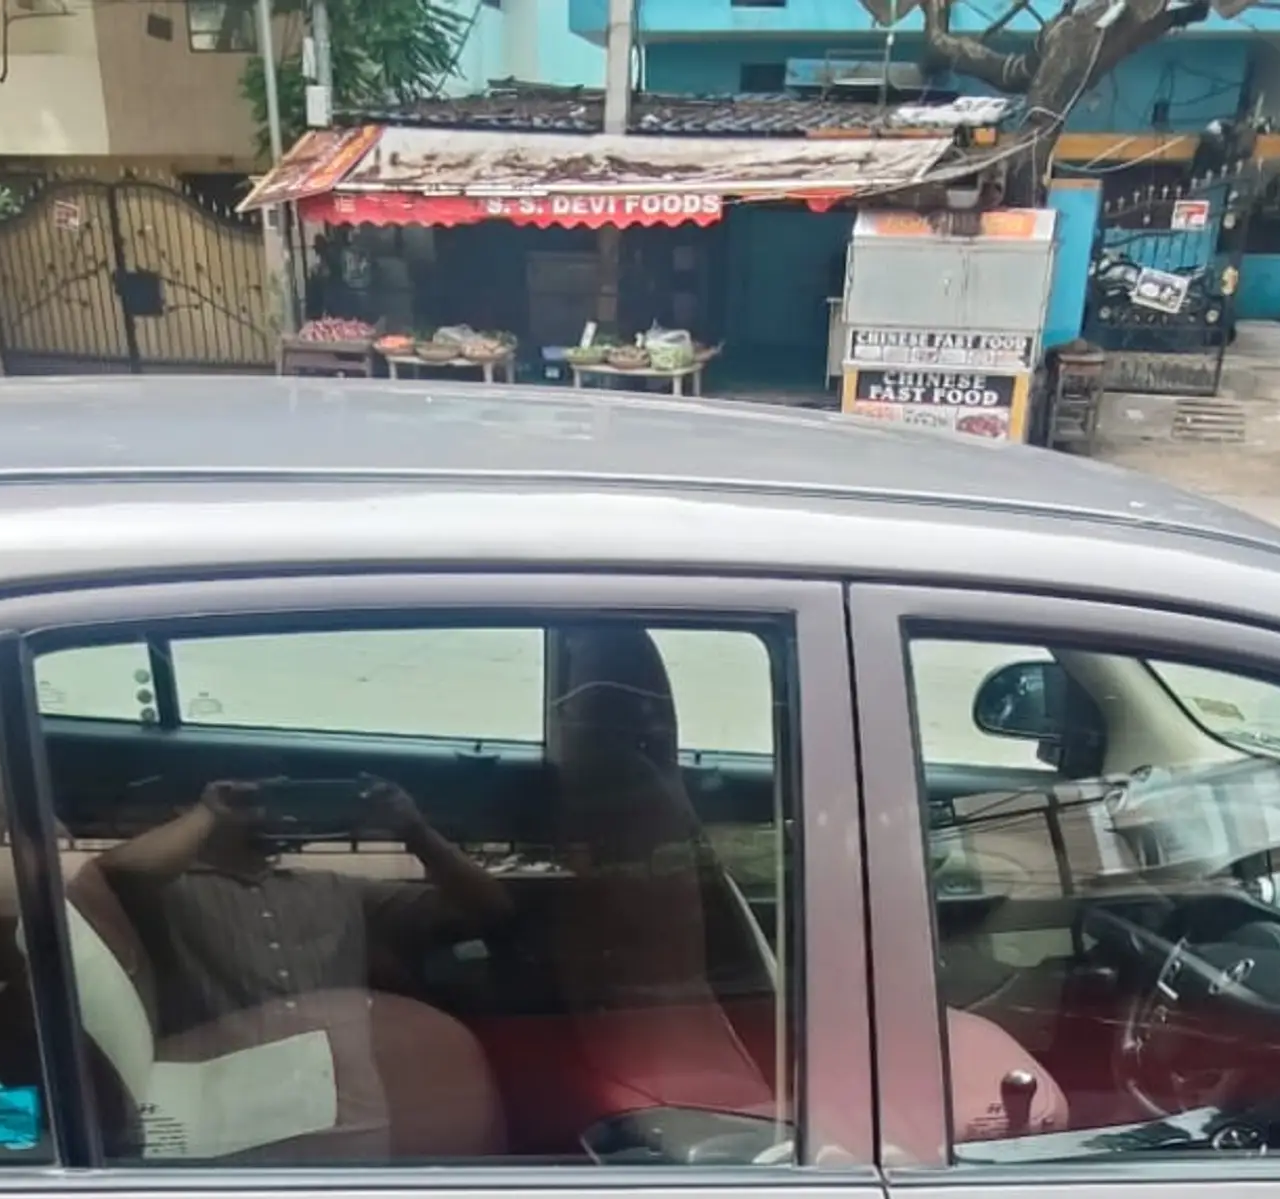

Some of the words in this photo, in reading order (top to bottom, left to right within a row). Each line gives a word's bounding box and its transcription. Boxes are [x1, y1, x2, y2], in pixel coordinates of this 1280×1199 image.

[487, 195, 510, 214] S.
[521, 195, 544, 214] S.
[553, 194, 616, 214] DEVI
[624, 194, 721, 214] FOODS
[856, 331, 928, 347] CHINESE
[934, 335, 972, 348] FAST
[981, 335, 1027, 350] FOOD
[883, 371, 987, 390] CHINESE
[869, 385, 926, 401] FAST
[933, 388, 999, 406] FOOD
